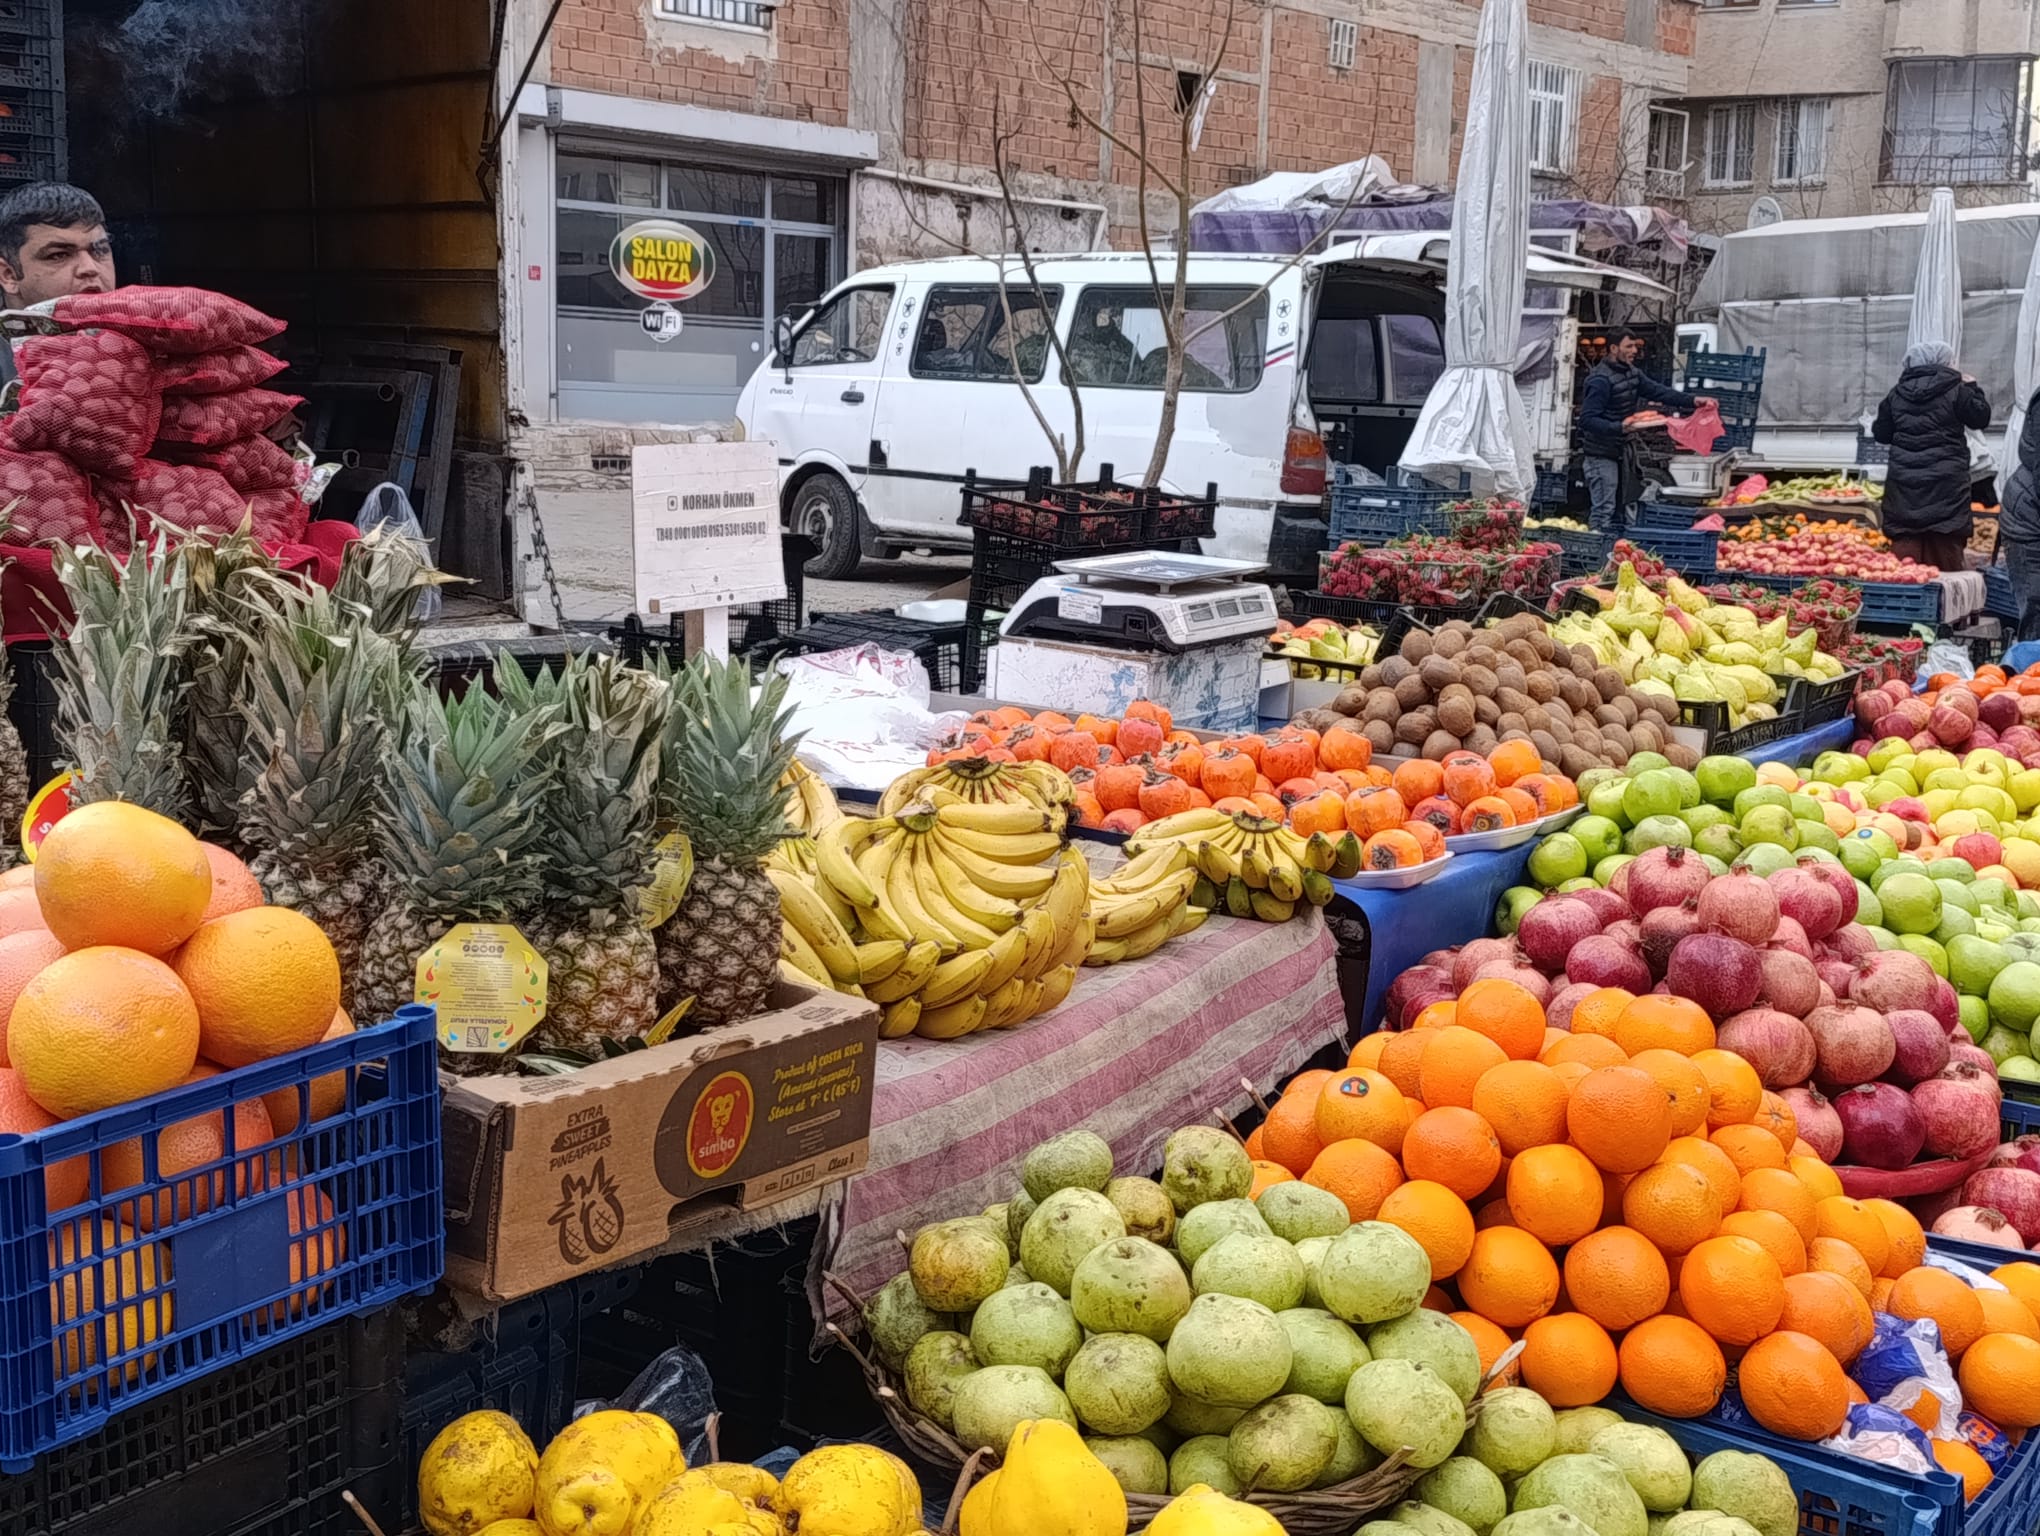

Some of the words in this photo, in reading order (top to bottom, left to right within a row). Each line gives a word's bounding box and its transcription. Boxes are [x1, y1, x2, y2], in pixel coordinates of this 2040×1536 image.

[631, 237, 692, 262] SALON
[632, 258, 692, 283] DAYZA
[682, 494, 721, 511] KORHAN
[723, 490, 755, 508] ÖKMEN
[819, 1049, 842, 1067] COSTA
[844, 1042, 864, 1058] RICA
[567, 1103, 603, 1128] EXTRA
[563, 1122, 603, 1148] SWEET
[698, 1136, 735, 1158] simba
[549, 1134, 612, 1172] PINEAPPLES
